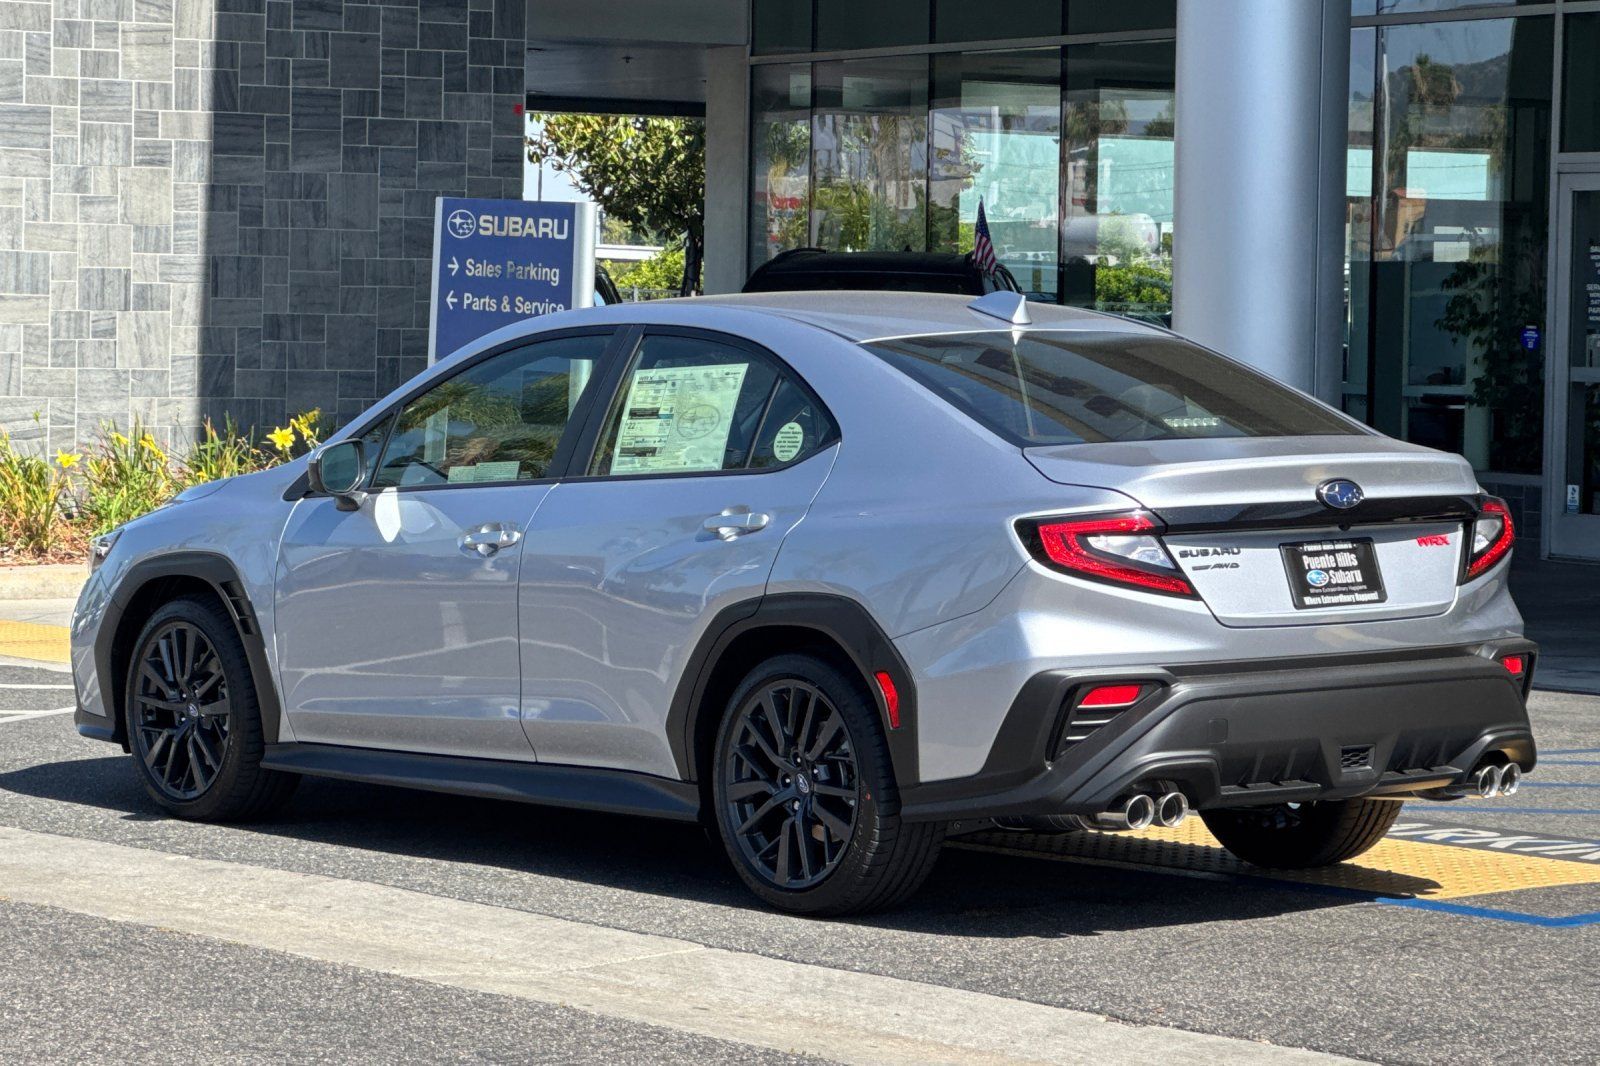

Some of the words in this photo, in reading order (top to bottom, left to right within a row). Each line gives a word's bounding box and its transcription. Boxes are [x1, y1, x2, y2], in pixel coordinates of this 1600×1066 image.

[478, 214, 569, 240] SUBARU
[465, 258, 502, 279] Sales
[506, 260, 560, 287] Parking
[463, 292, 497, 312] Parts
[501, 295, 511, 313] &
[514, 296, 565, 315] Service
[1416, 534, 1450, 547] WRX
[1179, 547, 1241, 558] SUBARU
[1302, 554, 1336, 569] Puente
[1335, 551, 1359, 567] Hills
[1211, 562, 1240, 570] AWD
[1328, 569, 1363, 584] Subaru
